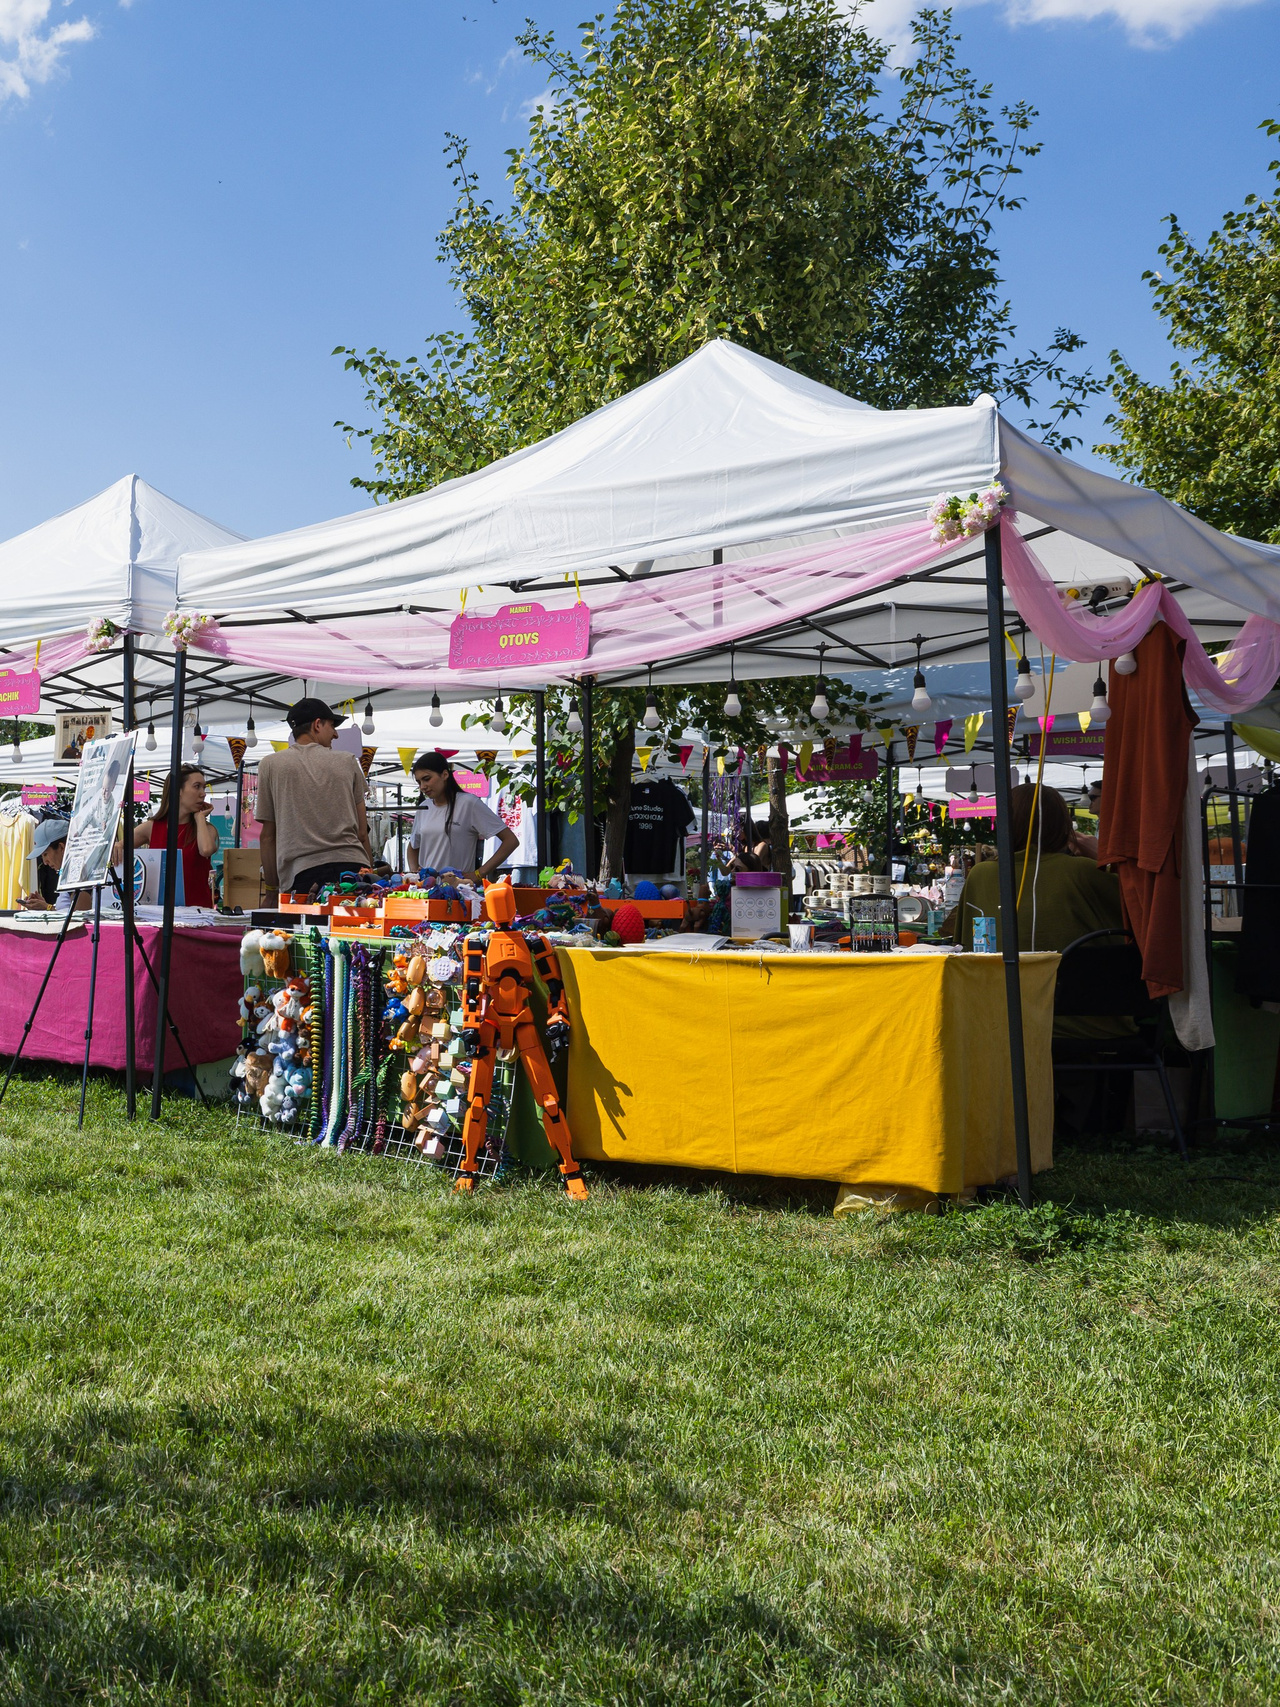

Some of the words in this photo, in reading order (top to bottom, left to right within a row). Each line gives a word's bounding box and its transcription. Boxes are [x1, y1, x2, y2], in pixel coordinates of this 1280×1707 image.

[509, 605, 532, 614] MARKET
[499, 631, 539, 649] QTOYS
[825, 763, 863, 771] CERAMCS
